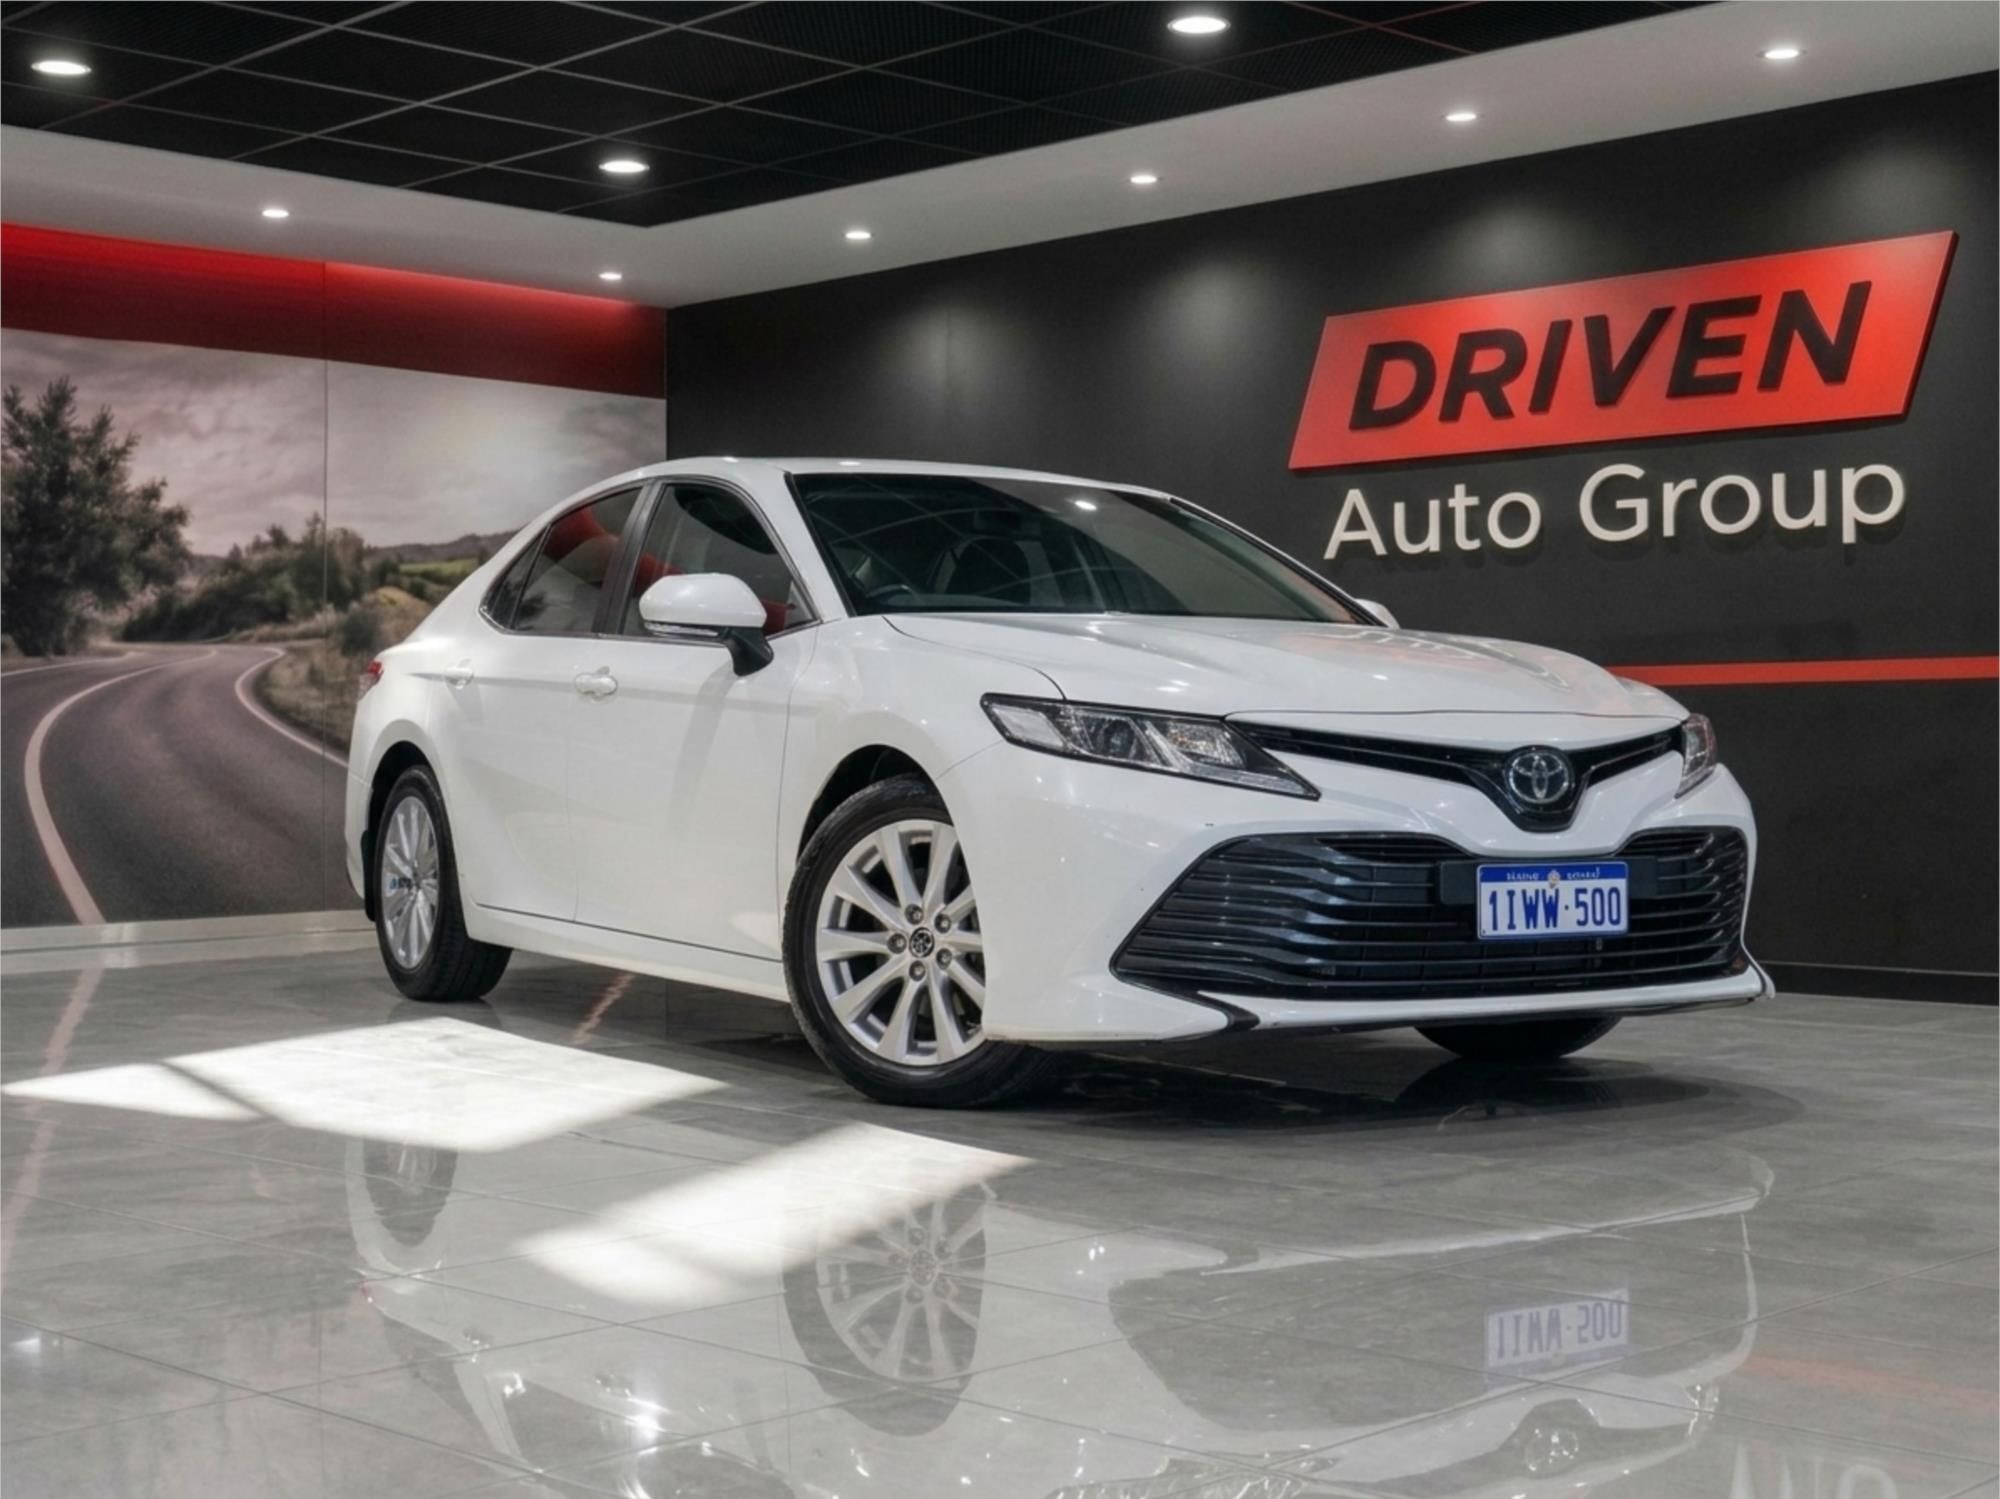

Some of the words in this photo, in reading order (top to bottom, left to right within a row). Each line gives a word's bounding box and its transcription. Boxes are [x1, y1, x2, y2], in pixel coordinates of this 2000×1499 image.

[1348, 280, 1872, 431] DRIVEN
[1323, 483, 1541, 560] Auto
[1579, 459, 1904, 544] Group
